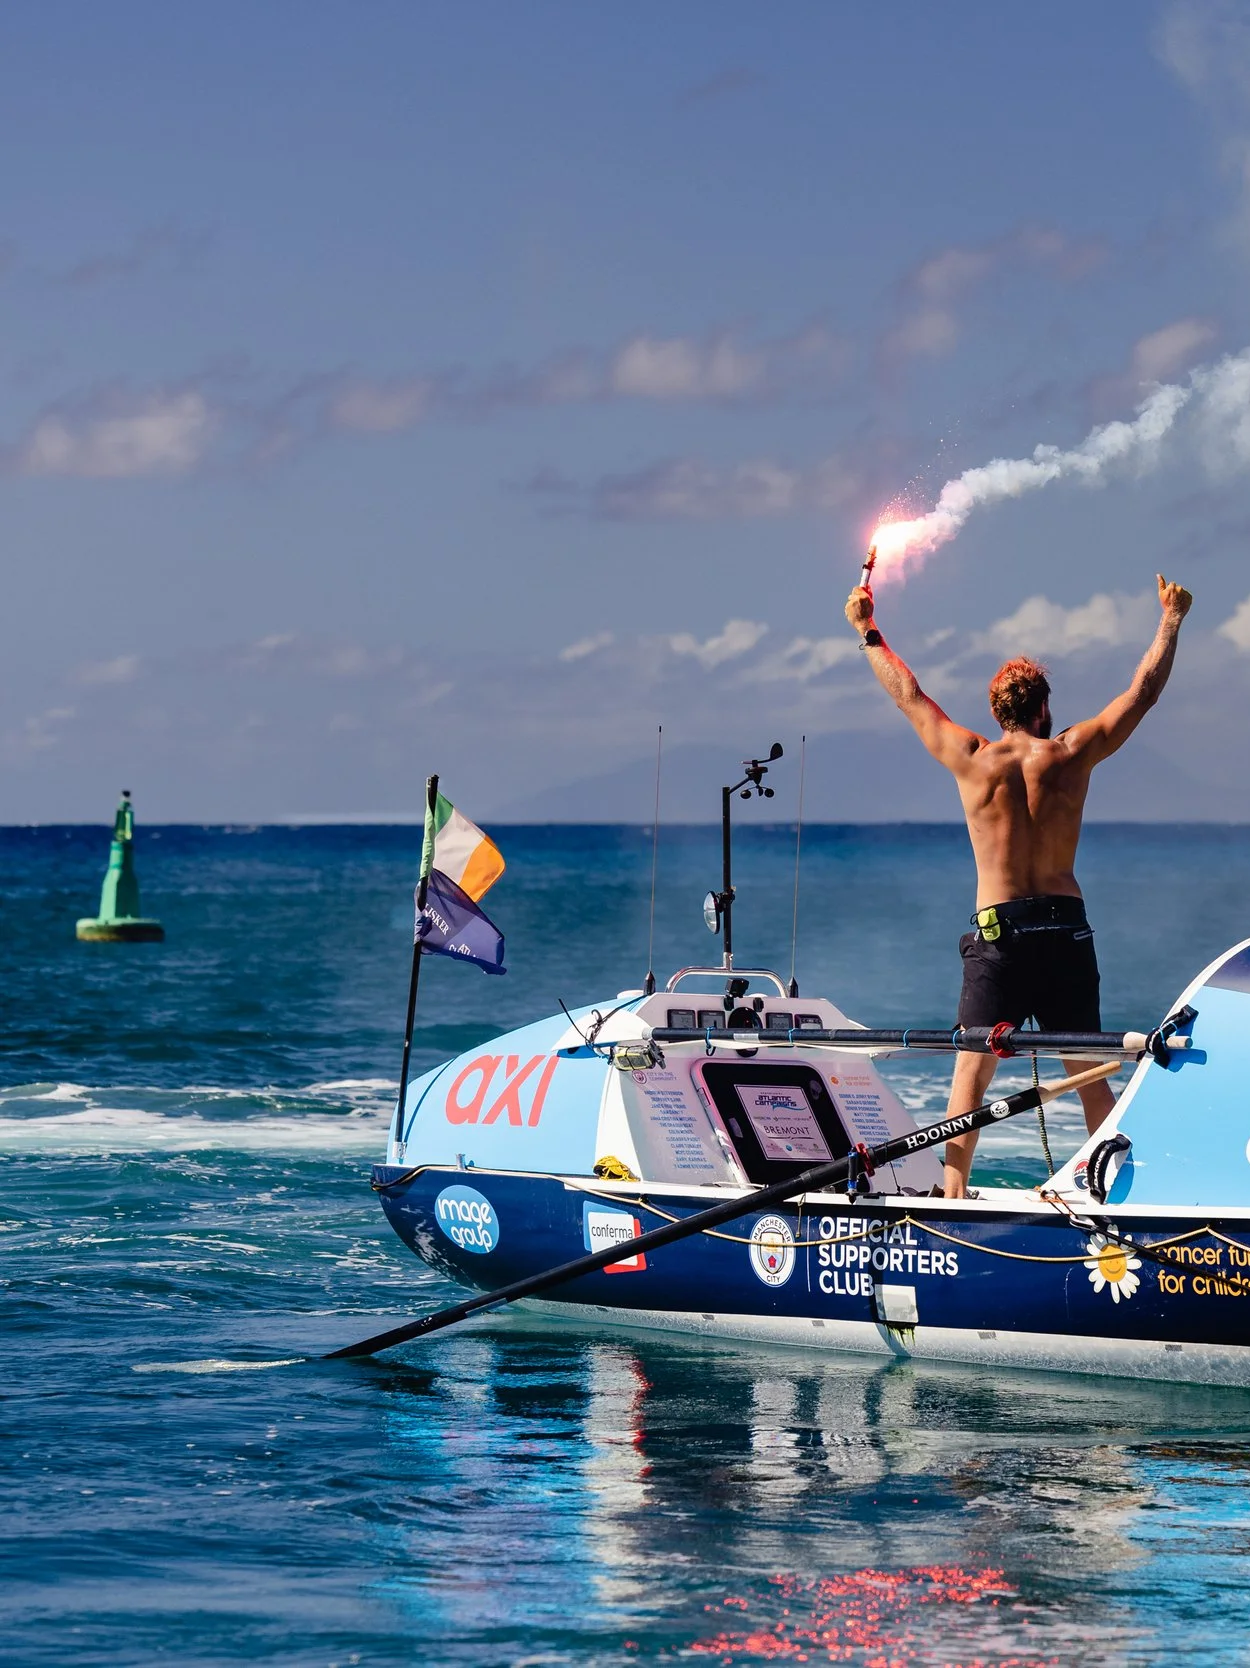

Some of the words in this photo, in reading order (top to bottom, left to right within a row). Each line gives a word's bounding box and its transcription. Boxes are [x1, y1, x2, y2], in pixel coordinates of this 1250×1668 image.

[763, 1125, 810, 1135] BREMONT
[904, 1113, 974, 1149] ANNOCH
[438, 1199, 492, 1228] image
[451, 1225, 493, 1253] group
[591, 1224, 634, 1239] conferma
[753, 1219, 791, 1242] MANCHESTER
[818, 1216, 918, 1246] OFFICIAL
[818, 1244, 959, 1276] SUPPORTERS
[1156, 1245, 1223, 1265] cancer
[766, 1275, 780, 1283] CITY
[818, 1270, 875, 1297] CLUB
[1158, 1269, 1187, 1294] for
